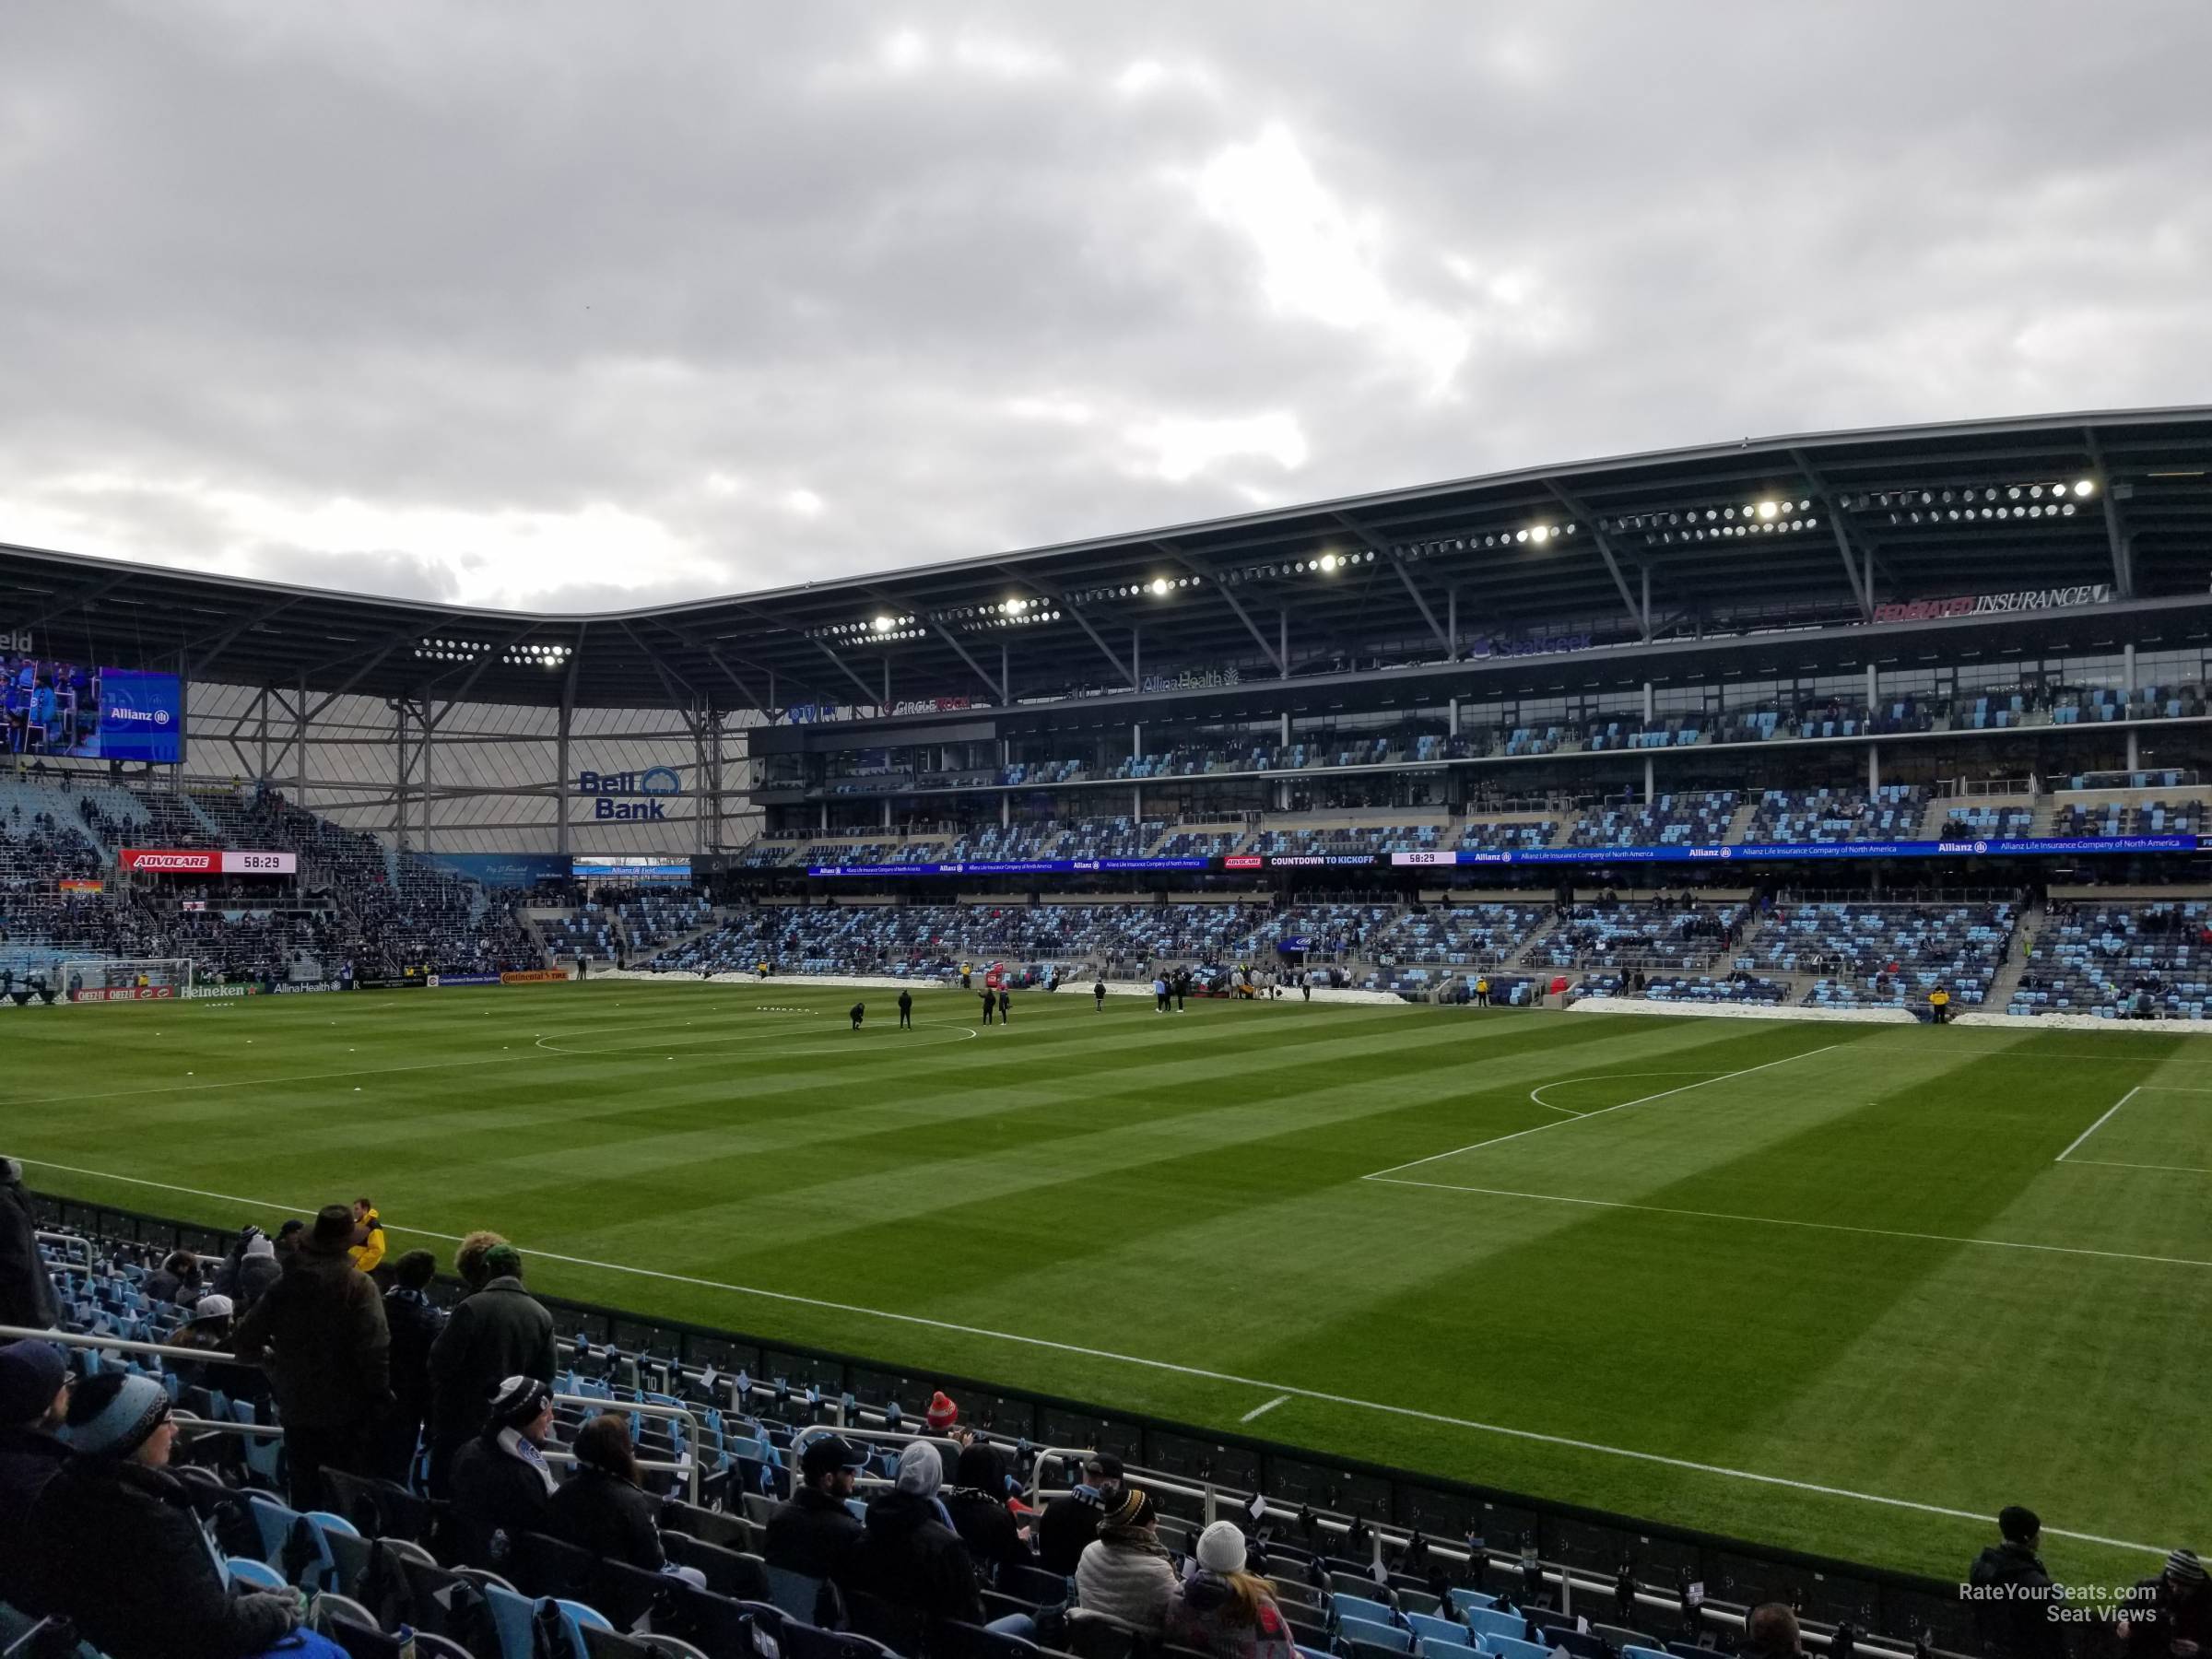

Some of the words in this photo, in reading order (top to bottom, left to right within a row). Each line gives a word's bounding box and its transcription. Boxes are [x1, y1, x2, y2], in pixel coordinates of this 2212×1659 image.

[1873, 596, 1974, 622] FEDERATED
[1975, 585, 2091, 613] INSURANCE
[111, 707, 152, 721] Allianz
[581, 771, 634, 793] Bell
[595, 798, 665, 819] Bank
[1938, 842, 1972, 852] Allianz
[2077, 841, 2114, 850] Company
[2115, 840, 2124, 848] of
[1688, 848, 1719, 856] Allianz
[1808, 846, 1840, 855] Company
[134, 854, 209, 868] ADVOCARE
[1271, 856, 1324, 865] COUNTDOWN
[1410, 853, 1435, 863] 58:29
[1577, 852, 1605, 860] Company
[244, 856, 279, 868] 58:29
[1226, 858, 1260, 866] ADVOCARE
[502, 972, 544, 982] Continental
[181, 985, 243, 998] Heineken
